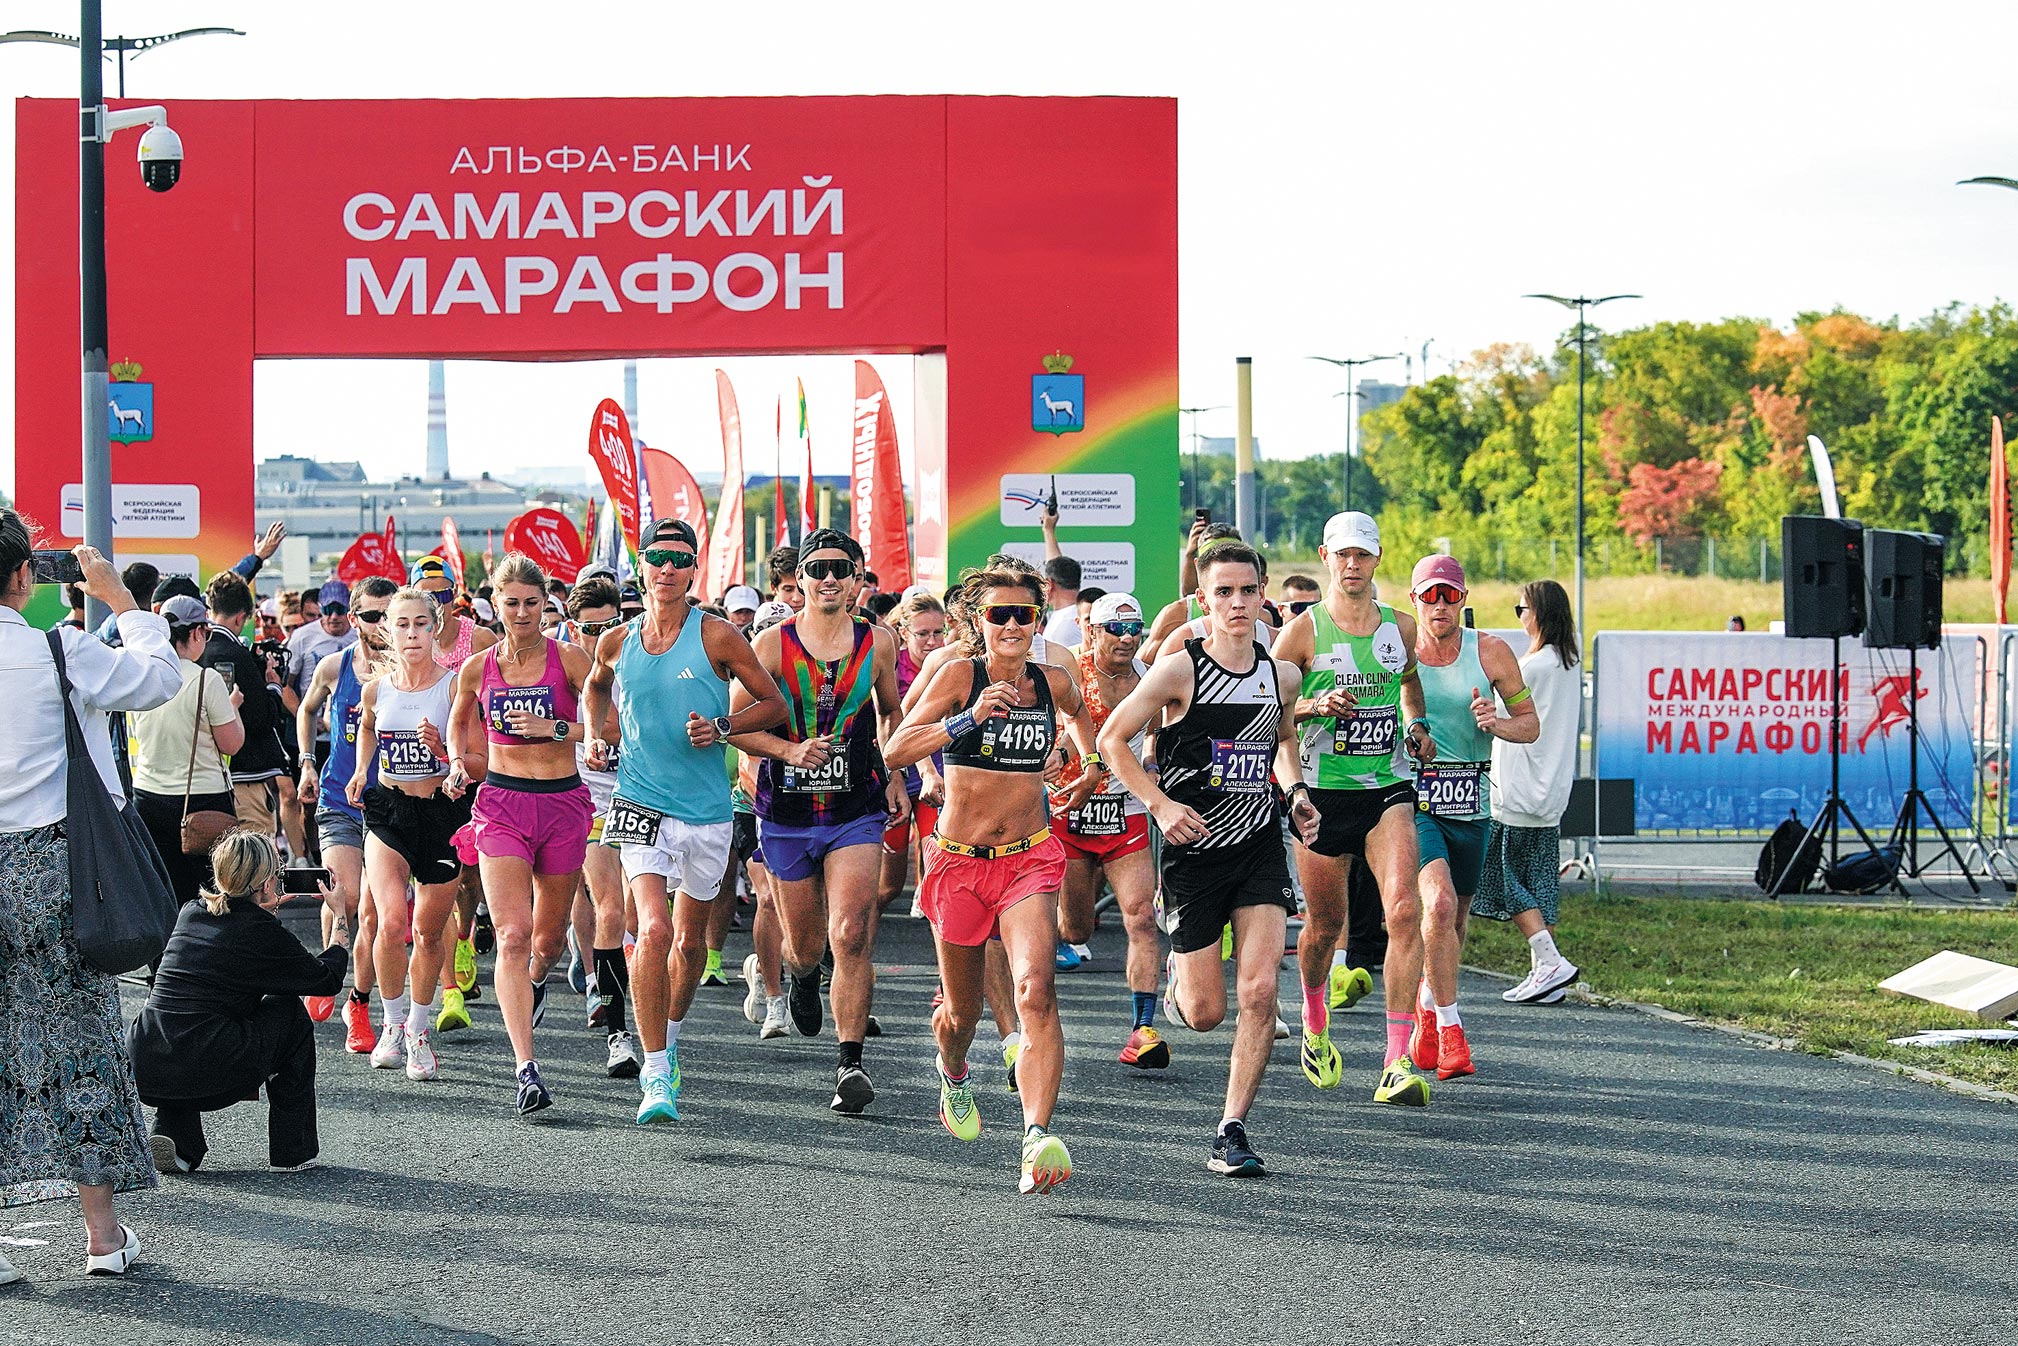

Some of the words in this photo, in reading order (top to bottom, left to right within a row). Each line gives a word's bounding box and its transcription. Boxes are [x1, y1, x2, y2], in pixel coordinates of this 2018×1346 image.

[449, 143, 753, 175] АЛЬФА-БАНК
[342, 175, 845, 242] САМАРСКИЙ
[345, 252, 844, 316] МАРАФОН
[1335, 673, 1364, 686] CLEAN
[1366, 671, 1393, 685] CLINIC
[1647, 662, 1850, 702] САМАРСКИЙ
[508, 688, 549, 697] МАРАФОН
[1347, 685, 1385, 698] SAMARA
[1009, 713, 1048, 721] МАРАФОН
[1358, 709, 1397, 719] МАРАФОН
[1648, 703, 1849, 718] МЕЖДУНАРОДНЫЙ
[998, 723, 1046, 751] 4195
[1348, 718, 1394, 744] 2269
[1646, 720, 1849, 755] МАРАФОН
[390, 741, 432, 763] 2153
[1360, 742, 1383, 751] ЮРИЙ
[394, 762, 430, 770] ДМИТРИЙ
[1226, 753, 1266, 780] 2175
[808, 778, 832, 787] ЮРИЙ
[1223, 780, 1265, 788] АЛЕКСАНДР
[1430, 779, 1475, 803] 2062
[614, 801, 659, 820] МАРАФОН
[1081, 802, 1120, 824] 4102
[1435, 802, 1471, 811] ДМИТРИЙ
[606, 809, 651, 834] 4156
[605, 831, 648, 841] ЛЕКСАНДР
